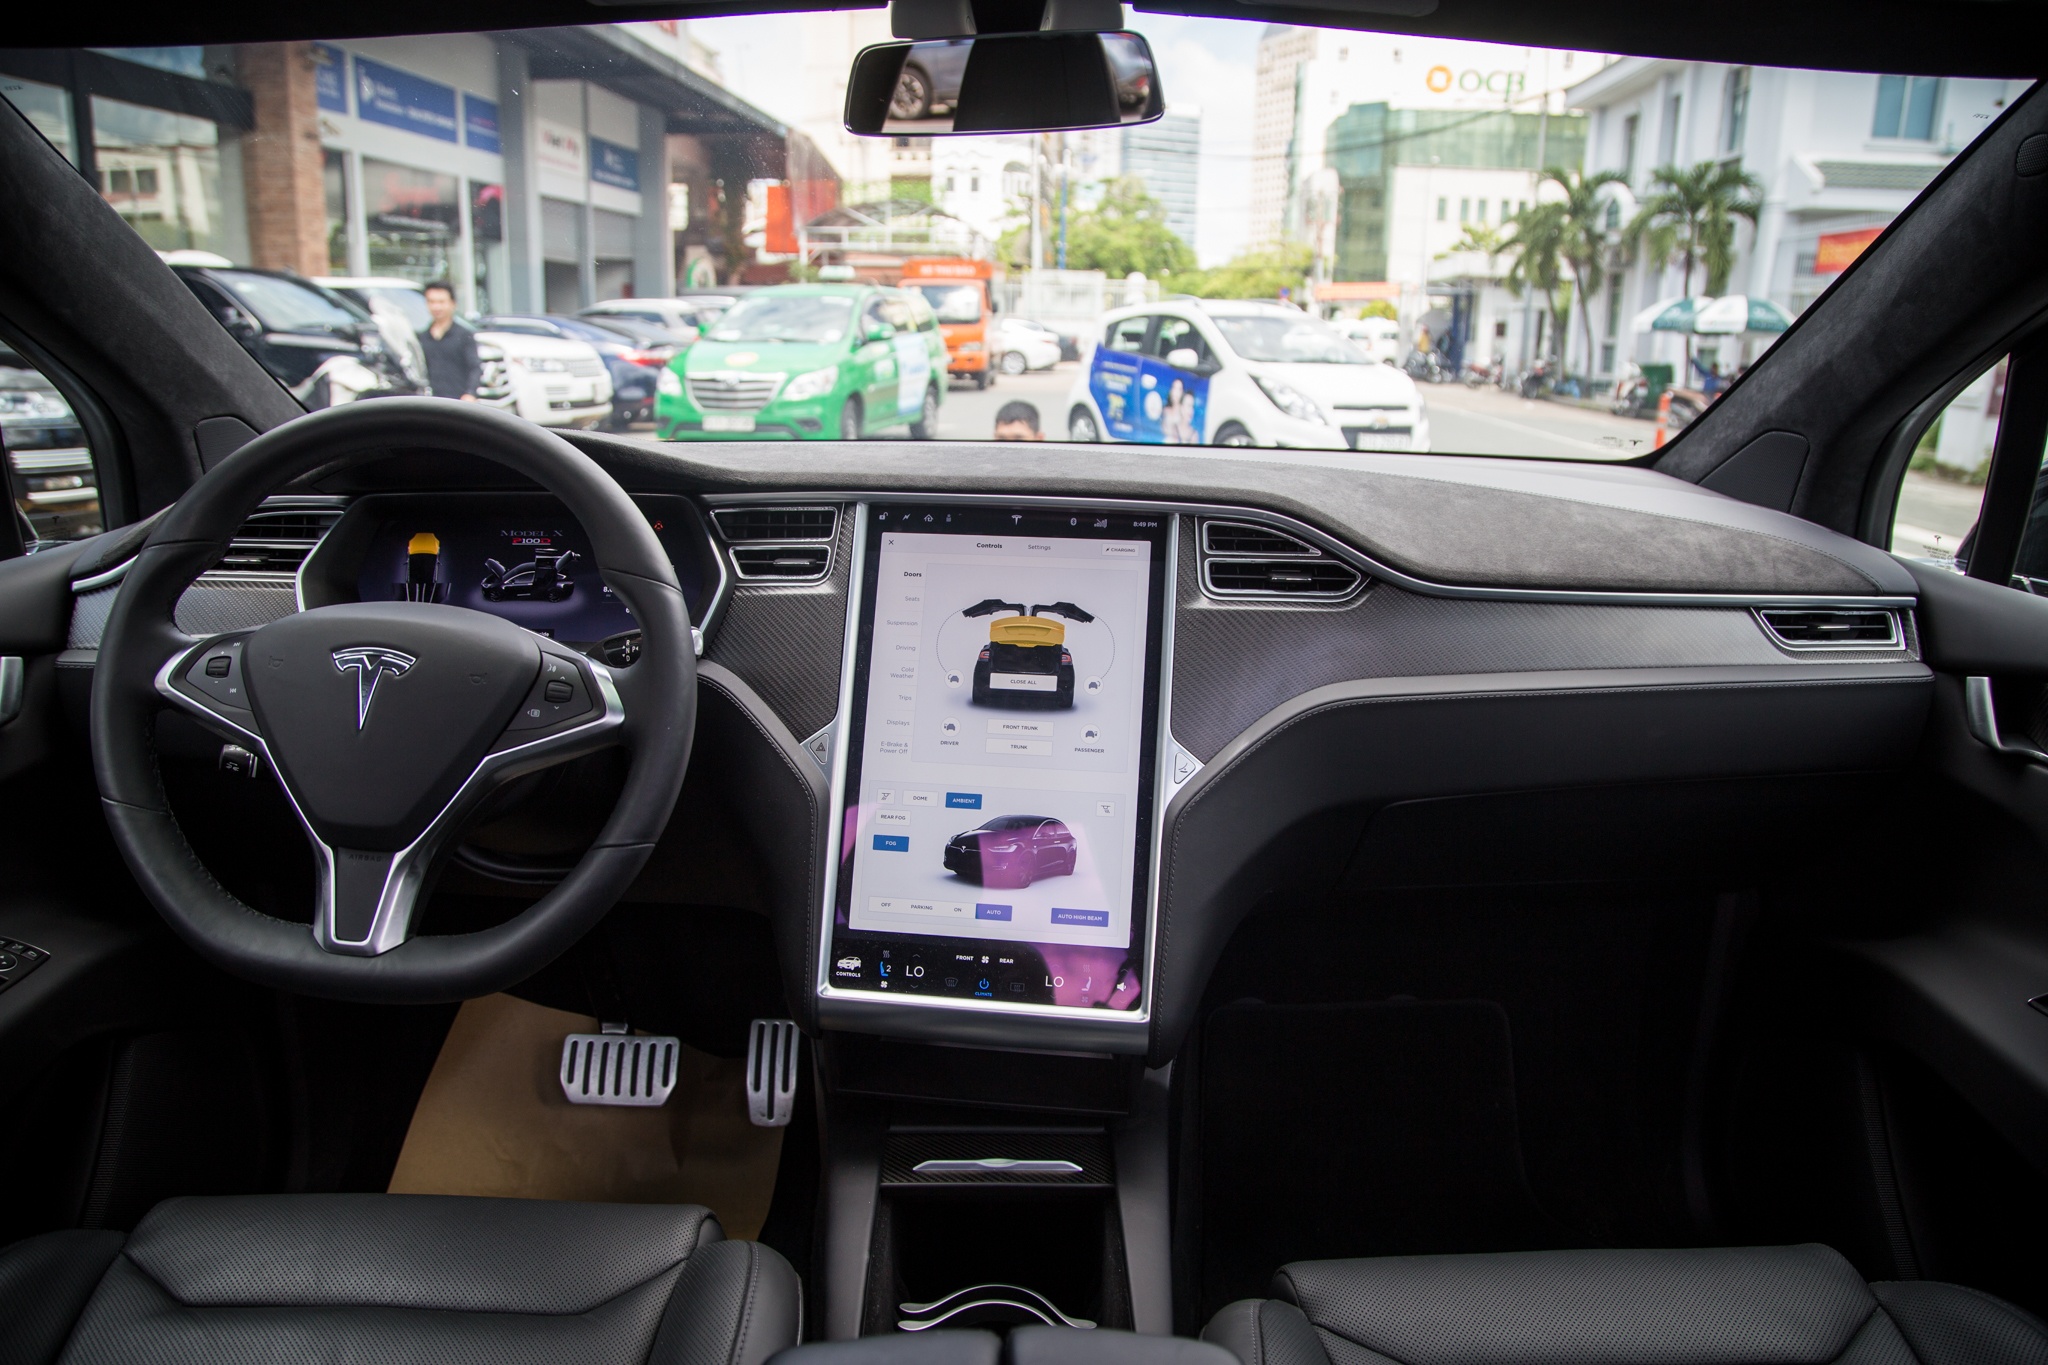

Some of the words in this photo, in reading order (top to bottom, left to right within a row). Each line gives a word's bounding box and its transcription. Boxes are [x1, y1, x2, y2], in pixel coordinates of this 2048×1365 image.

[1458, 68, 1525, 93] OCB
[348, 854, 382, 862] AIRBAG
[886, 964, 892, 972] 2
[905, 965, 925, 977] LO
[1045, 975, 1064, 987] LO
